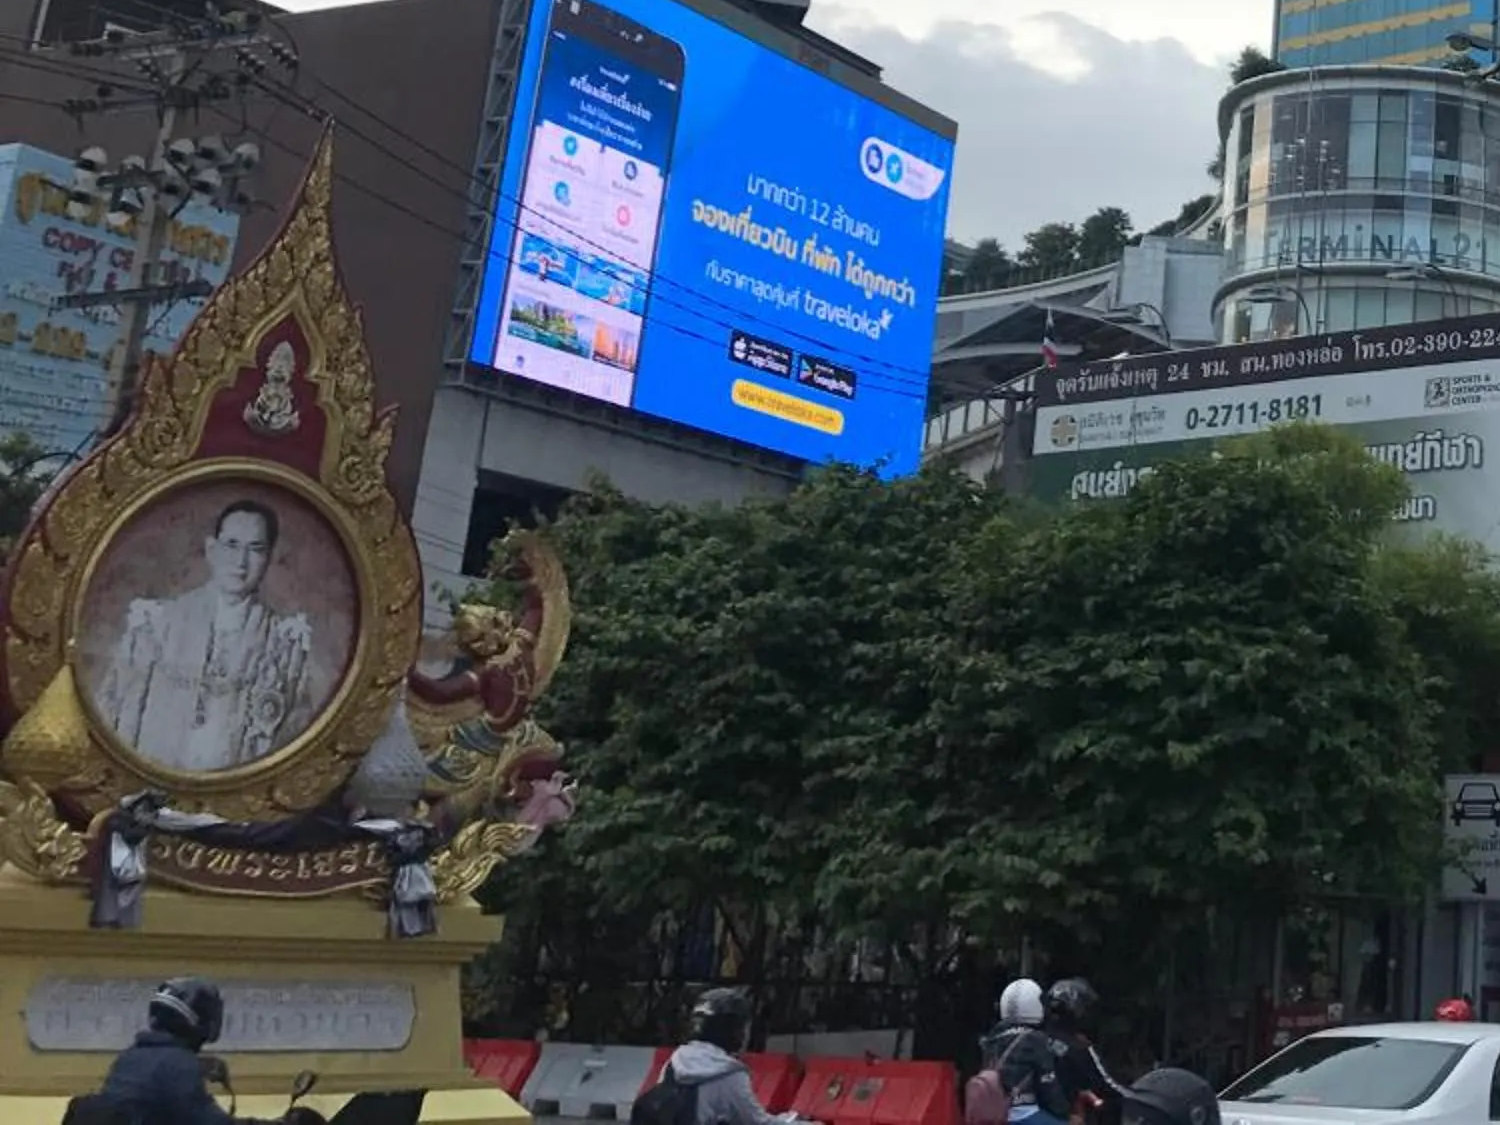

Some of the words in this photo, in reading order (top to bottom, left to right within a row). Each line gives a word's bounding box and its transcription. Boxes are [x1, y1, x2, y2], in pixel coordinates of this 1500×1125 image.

[747, 173, 806, 216] มากกว่า
[810, 198, 830, 226] 12
[831, 204, 880, 247] ล้านคน
[691, 198, 798, 261] จองเที่ยวบิน
[801, 232, 842, 279] ที่พัก
[845, 250, 916, 308] ได้ถูกกว่า
[804, 291, 882, 341] traveloka
[1056, 363, 1159, 400] จุดรับแจ้งเหตุ
[1167, 363, 1189, 383] 24
[1201, 357, 1230, 378] ชม.
[1240, 337, 1344, 374] สน.ทองหล่อ
[1186, 392, 1323, 431] 0-2711-8181
